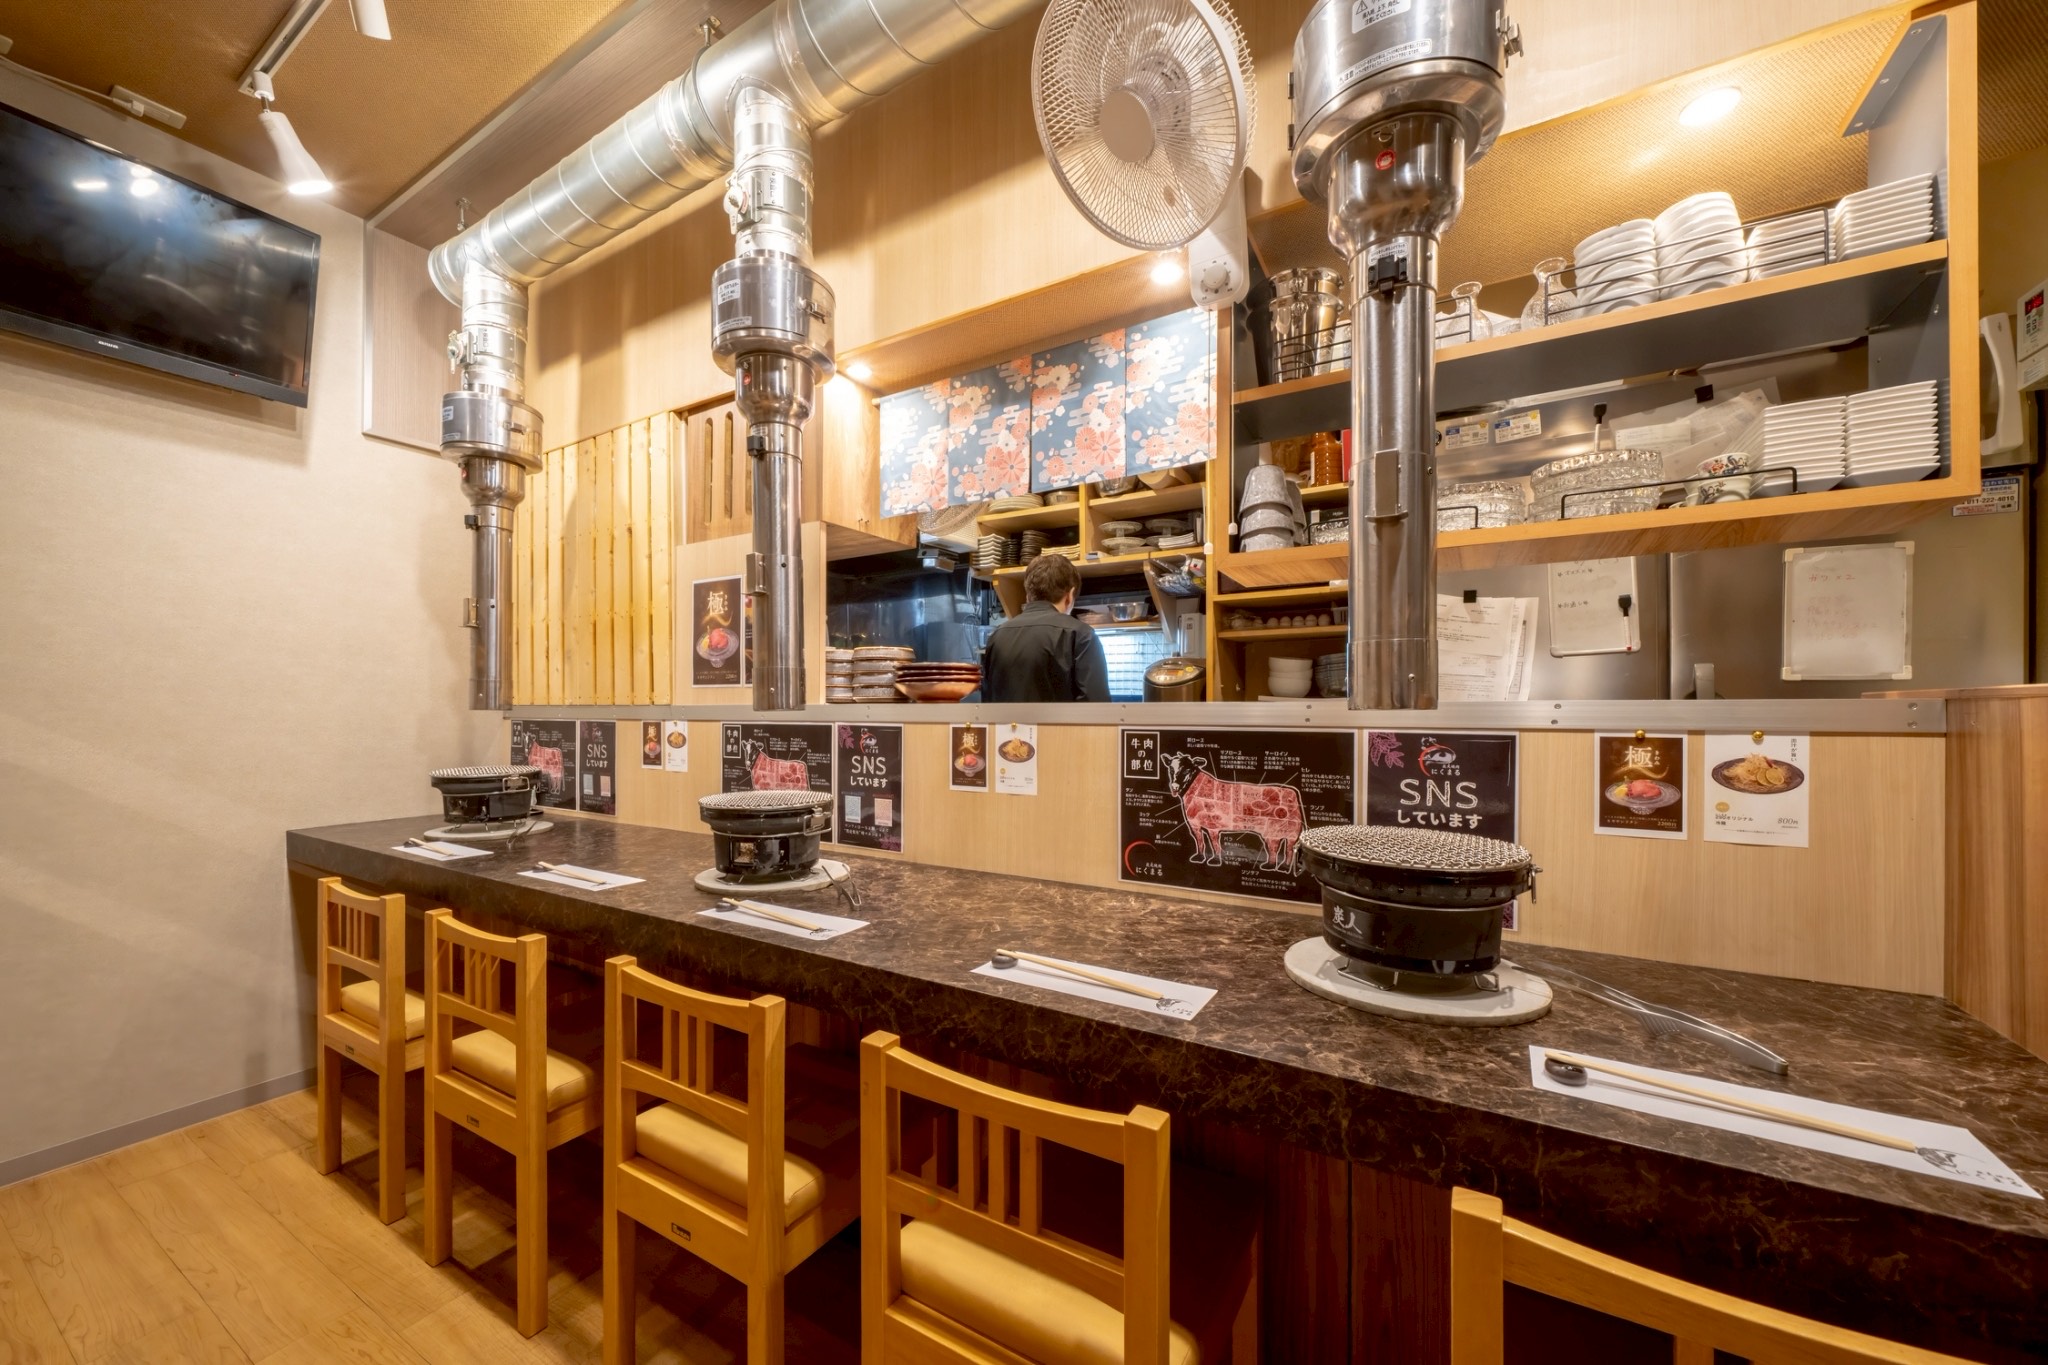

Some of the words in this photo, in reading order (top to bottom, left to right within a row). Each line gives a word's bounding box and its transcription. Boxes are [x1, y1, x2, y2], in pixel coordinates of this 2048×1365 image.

[707, 591, 724, 615] 極
[962, 732, 975, 747] 極
[1131, 738, 1153, 749] 牛肉
[587, 744, 607, 759] SNS
[1624, 745, 1653, 768] 極
[586, 759, 608, 768] しています
[851, 756, 886, 775] SNS
[1131, 760, 1154, 771] 部位
[851, 777, 888, 788] しています
[1400, 778, 1479, 809] SNS
[1397, 810, 1482, 829] しています
[1136, 867, 1163, 876] にくまる
[1332, 905, 1362, 934] 炭人
